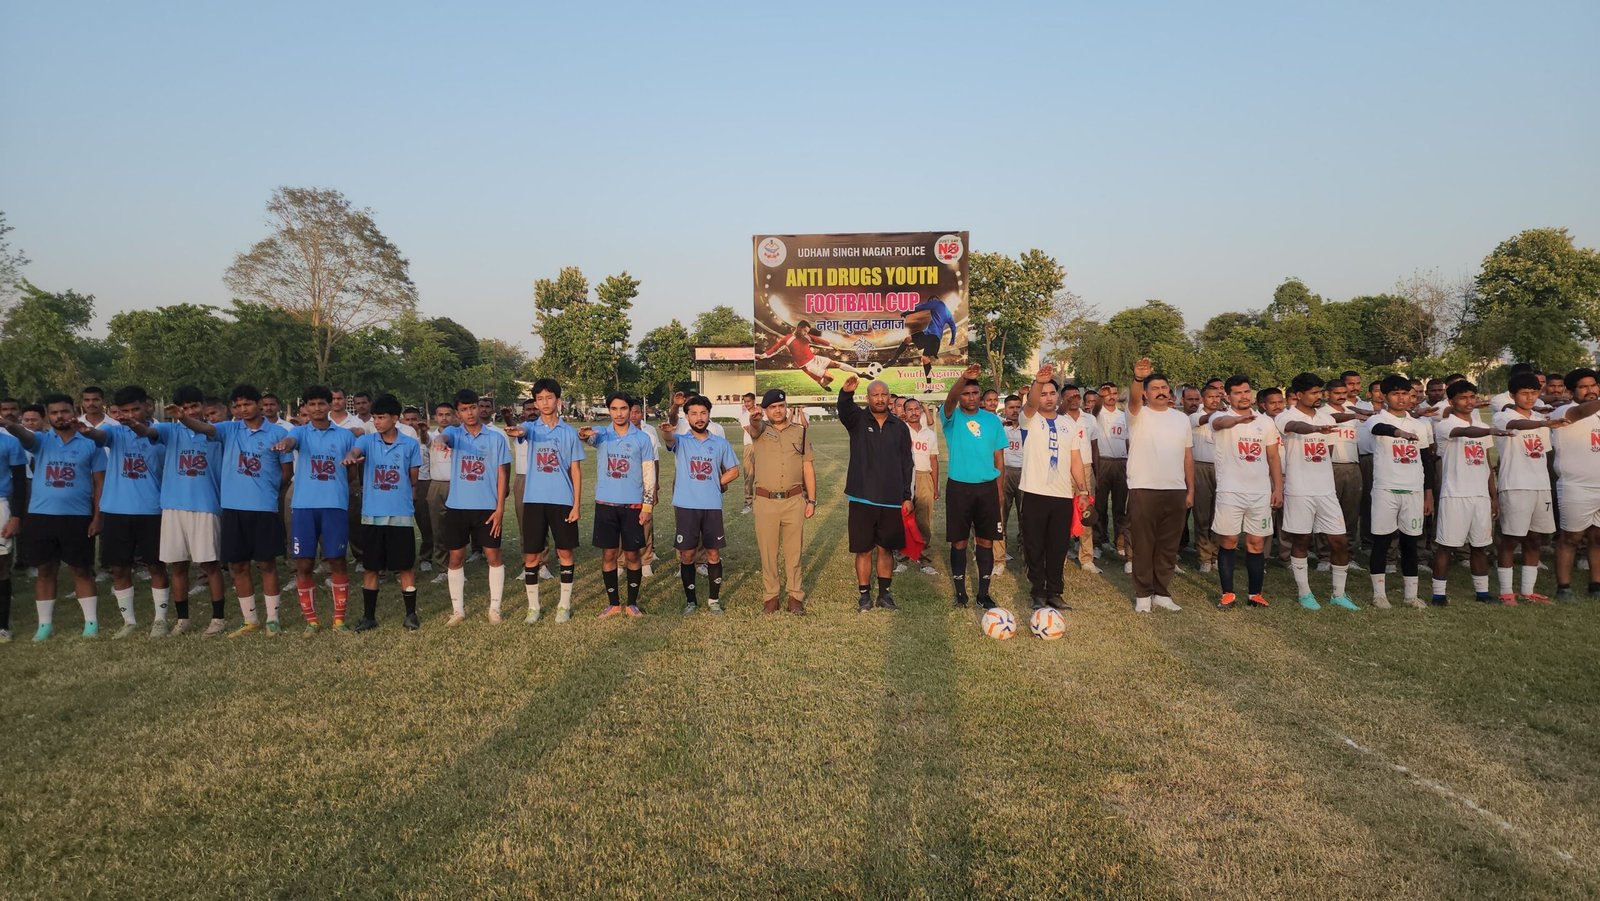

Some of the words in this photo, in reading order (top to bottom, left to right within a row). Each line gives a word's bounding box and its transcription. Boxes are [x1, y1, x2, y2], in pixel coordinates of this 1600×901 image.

[798, 248, 830, 258] UDHAM
[832, 248, 860, 257] SINGH
[862, 247, 893, 257] NAGAR
[895, 246, 926, 256] POLICE
[785, 268, 823, 287] ANTI
[826, 267, 882, 287] DRUGS
[885, 266, 939, 285] YOUTH
[805, 293, 884, 314] FOOTBALL
[885, 292, 920, 312] CUP
[816, 320, 840, 331] नशा
[843, 320, 869, 335] मुक्त
[871, 319, 904, 330] समाज
[897, 370, 925, 378] Youth
[915, 382, 945, 391] Drugs
[1111, 427, 1122, 435] 10
[997, 522, 1003, 533] 5
[294, 543, 300, 555] 5
